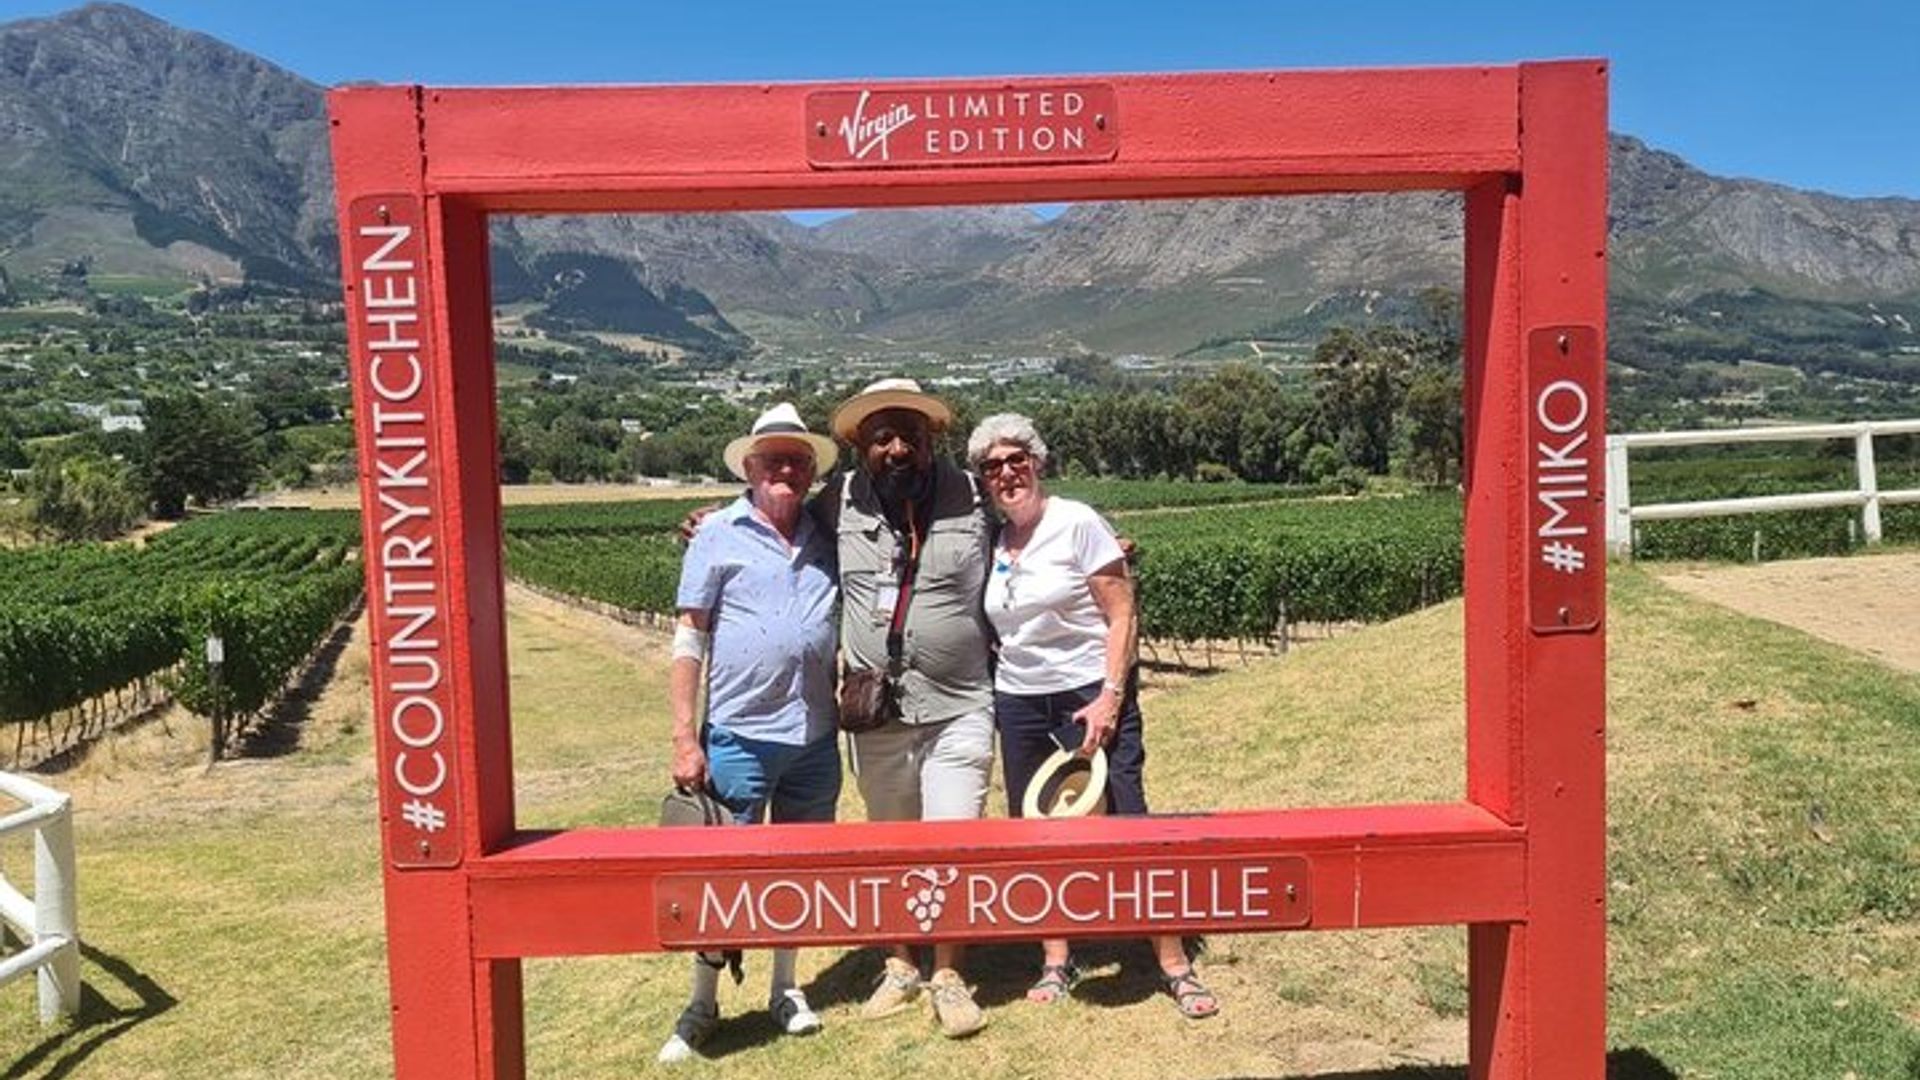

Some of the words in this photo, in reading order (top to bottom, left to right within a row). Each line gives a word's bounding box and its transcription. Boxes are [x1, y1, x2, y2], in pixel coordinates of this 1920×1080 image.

[838, 90, 917, 160] Virgin
[925, 92, 1084, 119] LIMITED
[926, 126, 1084, 153] EDITION
[1537, 380, 1589, 574] #MIKO
[360, 224, 447, 833] #COUNTRYKITCHEN
[698, 878, 891, 933] MONT
[968, 866, 1270, 924] ROCHELLE
